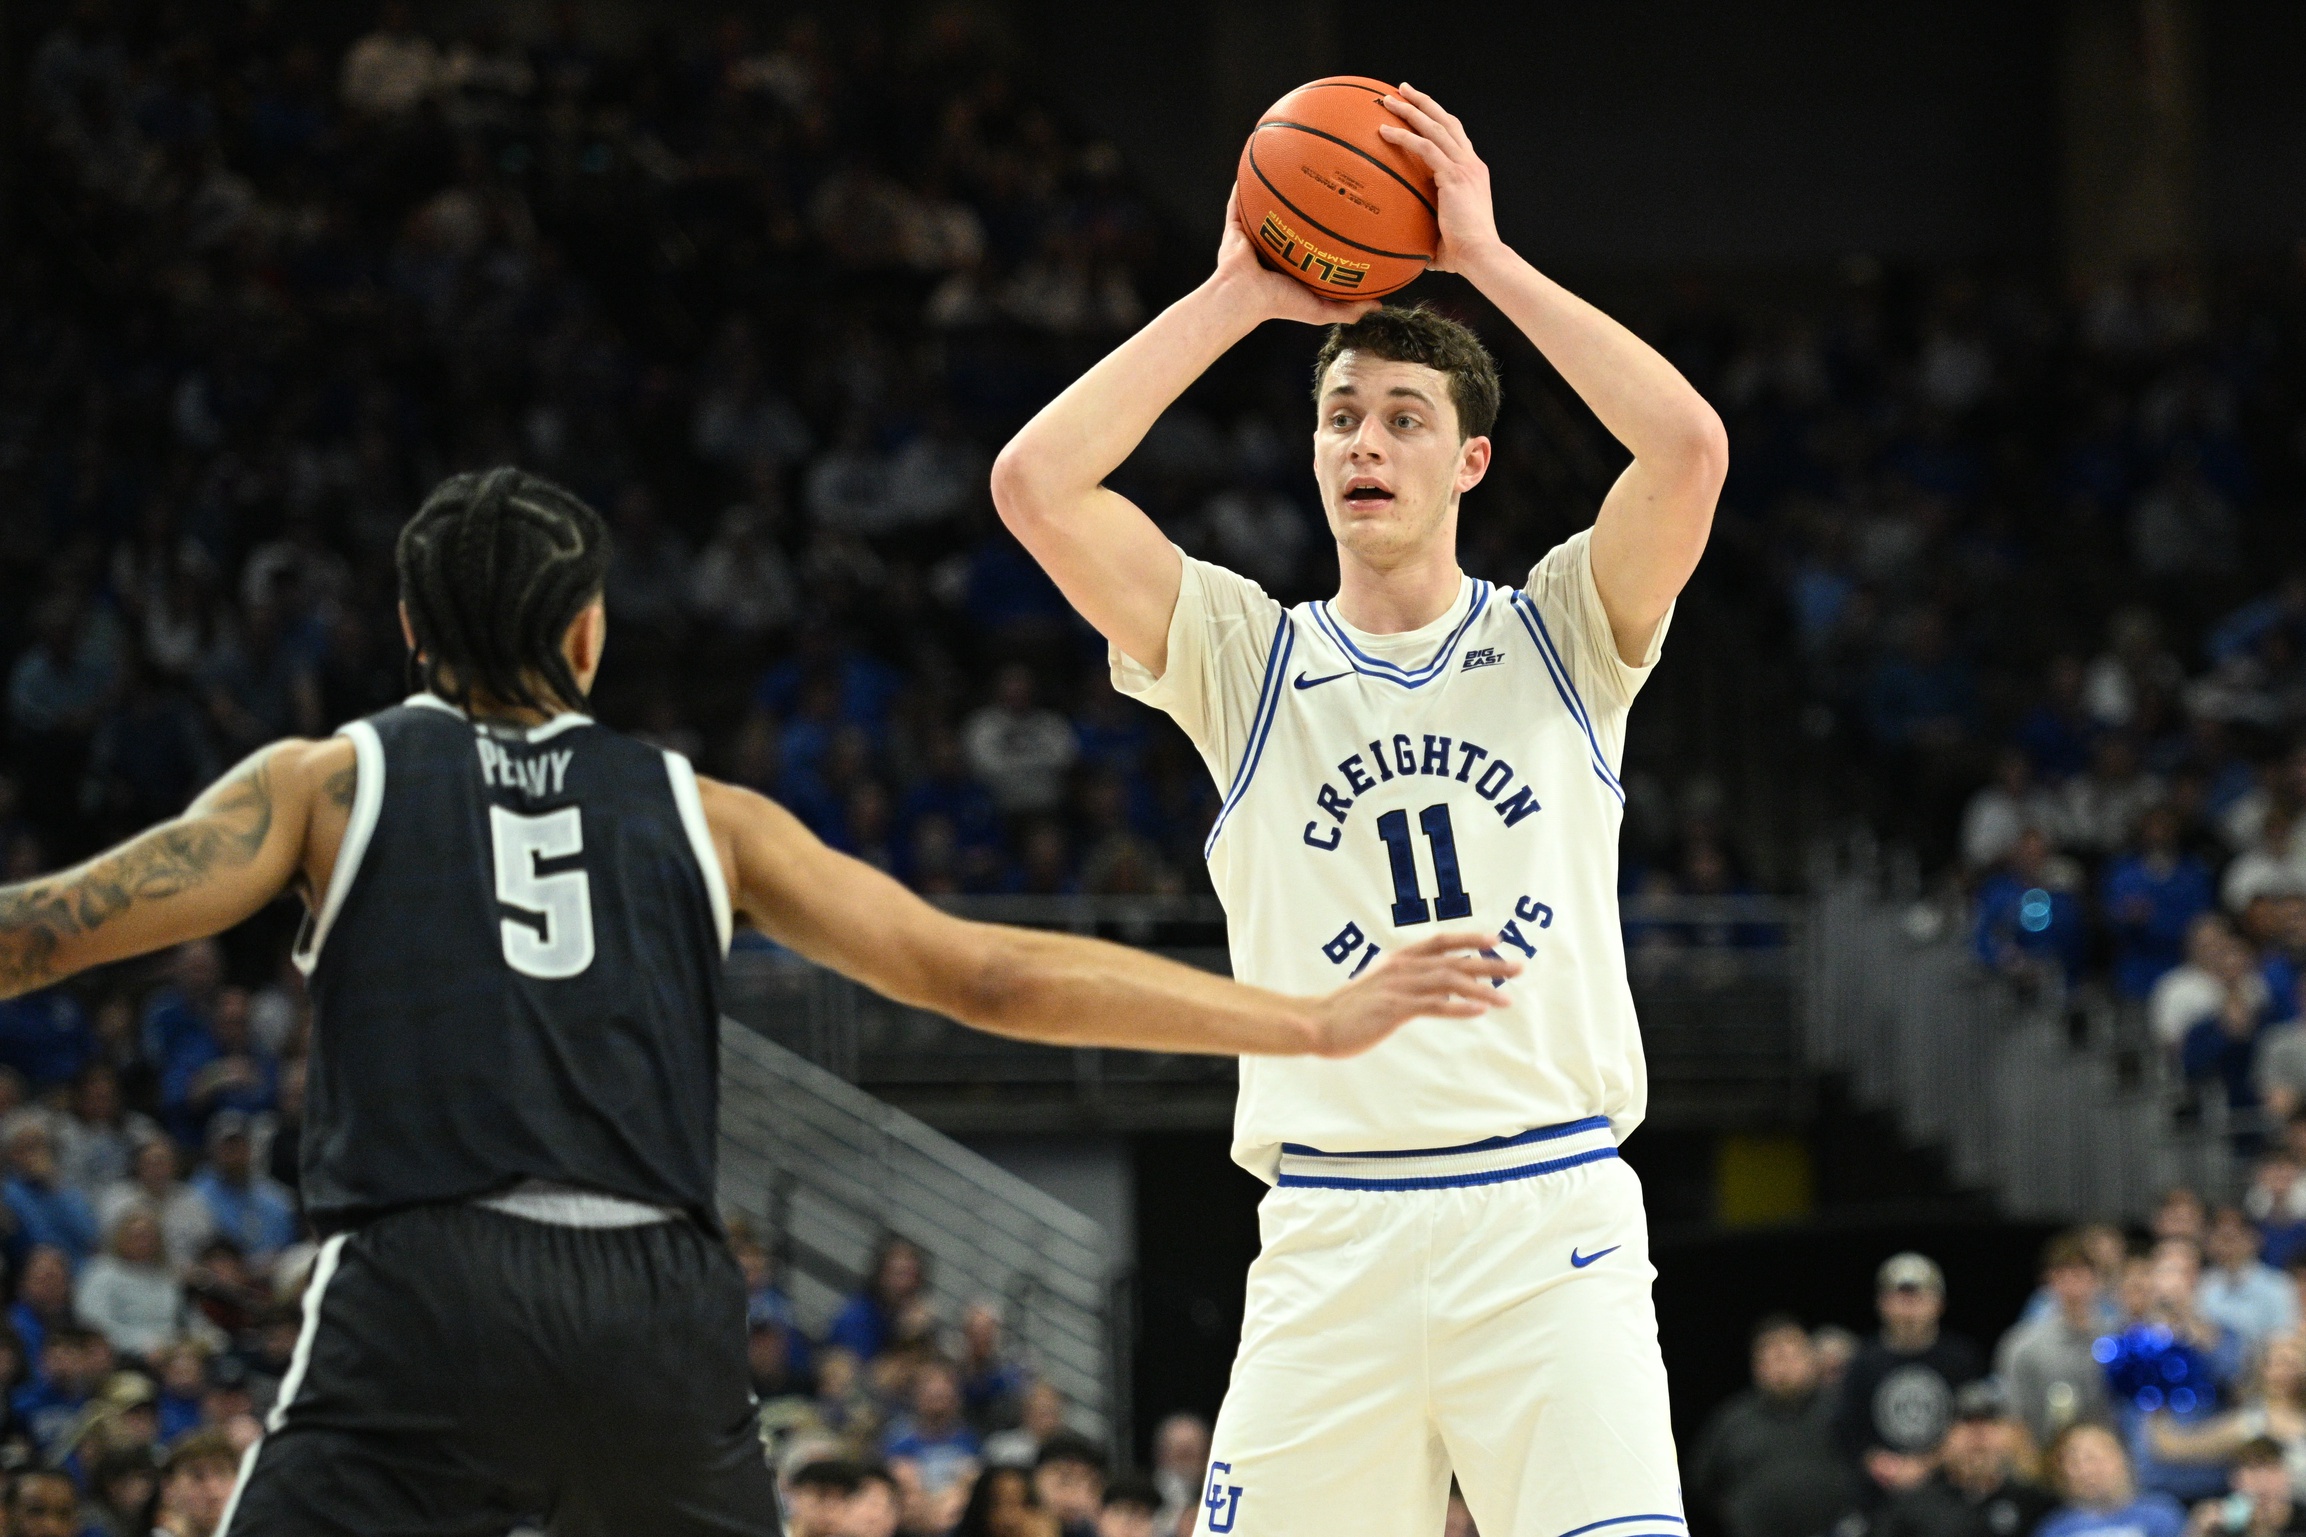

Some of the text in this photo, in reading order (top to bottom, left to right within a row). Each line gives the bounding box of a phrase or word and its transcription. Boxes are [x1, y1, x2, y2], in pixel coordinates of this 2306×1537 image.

[1259, 215, 1367, 288] ELITE
[1269, 210, 1370, 270] CHAMPIONSHIP
[1462, 653, 1505, 668] EAST
[1465, 647, 1494, 660] BIG
[1303, 733, 1542, 852] CREIGHTON
[488, 803, 595, 980] 5
[1376, 803, 1473, 928] 11
[1205, 1461, 1244, 1534] CU
